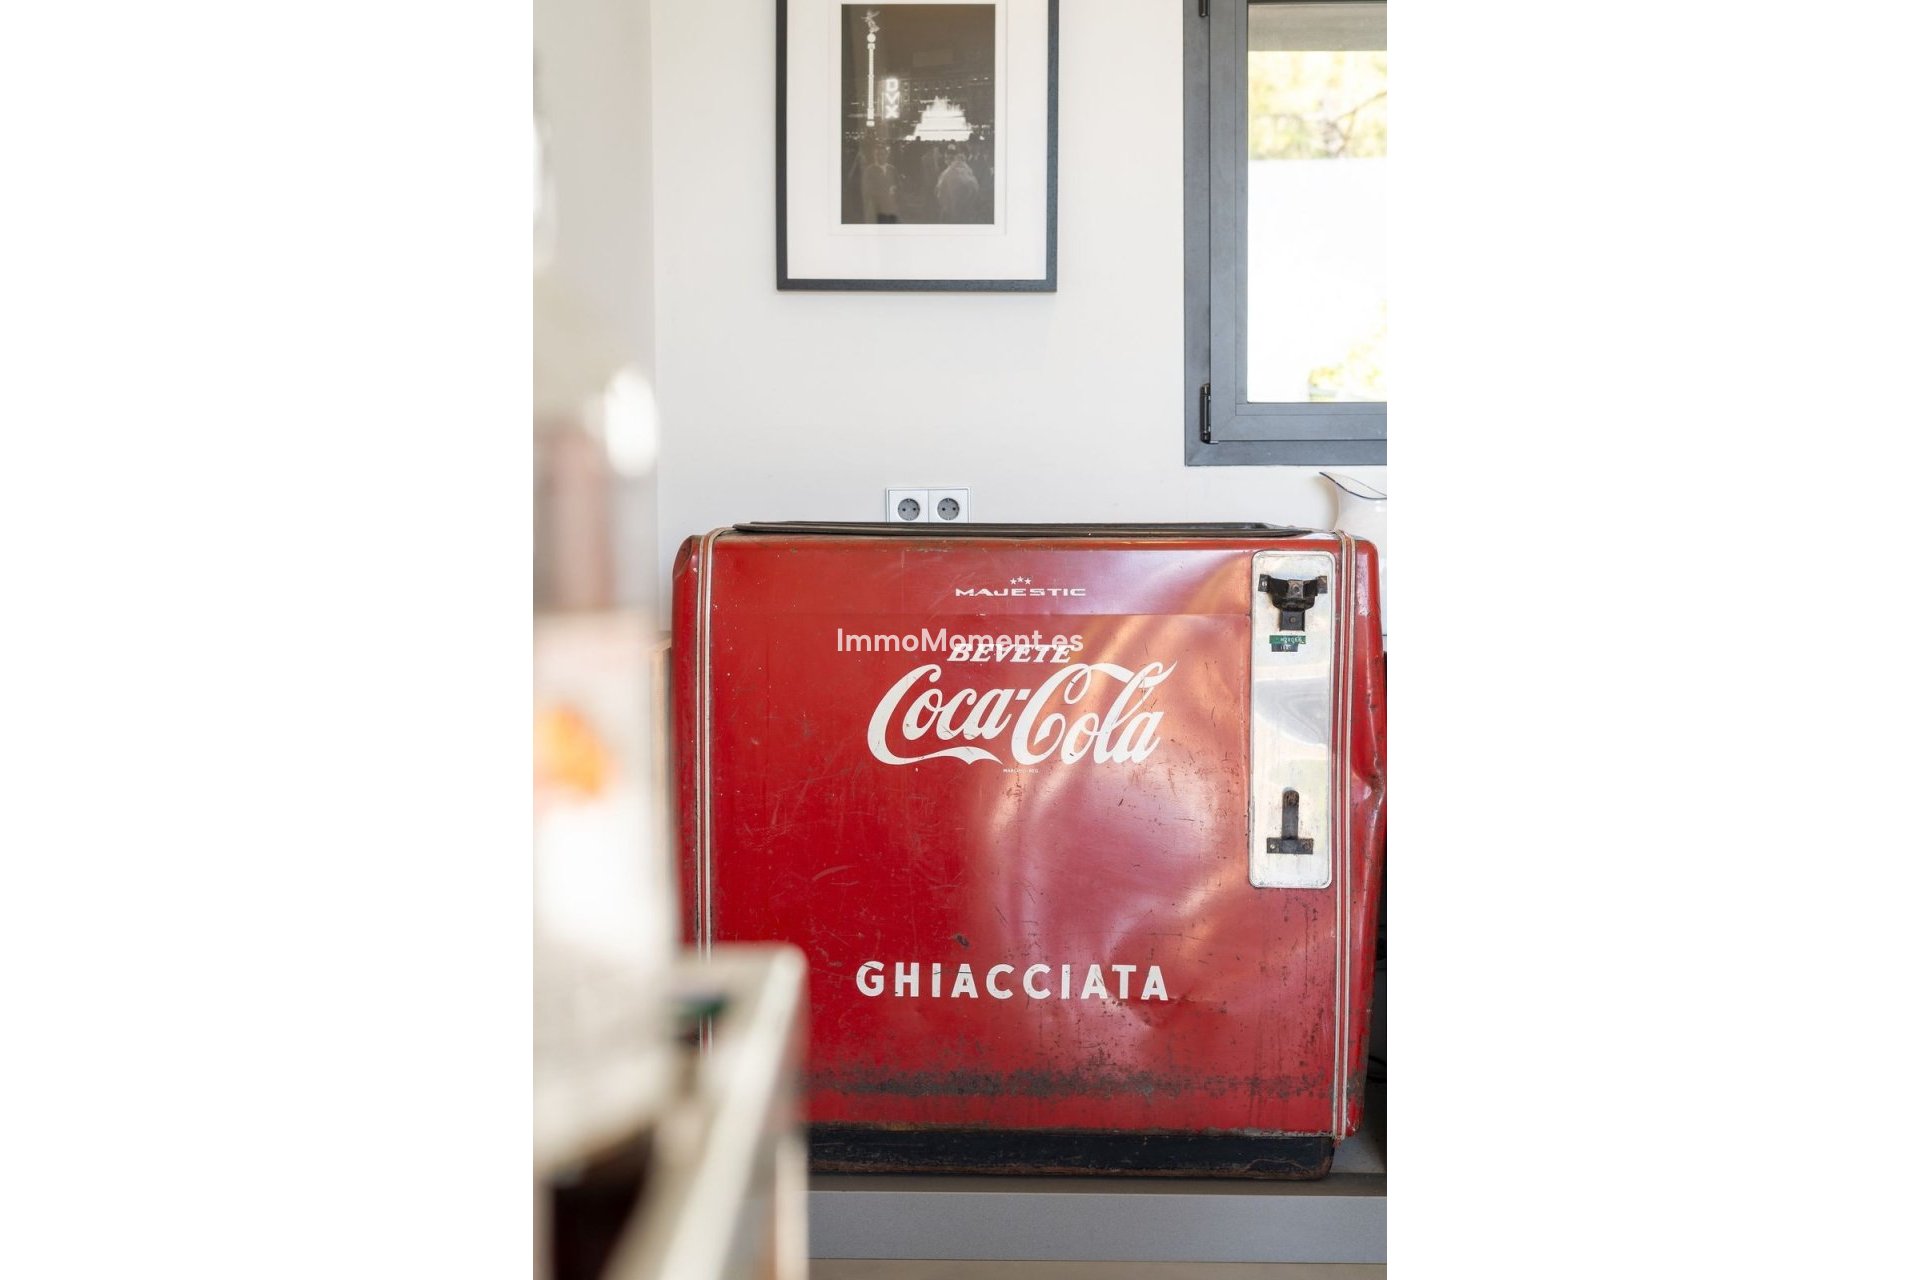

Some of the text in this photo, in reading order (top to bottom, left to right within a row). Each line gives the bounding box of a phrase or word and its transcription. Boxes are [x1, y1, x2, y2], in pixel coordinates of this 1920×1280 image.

[955, 587, 1086, 597] MAJESTIC
[947, 643, 1074, 663] BEVETE
[867, 660, 1178, 766] Coca-Cola
[855, 960, 1169, 1001] GHIACCIATA
